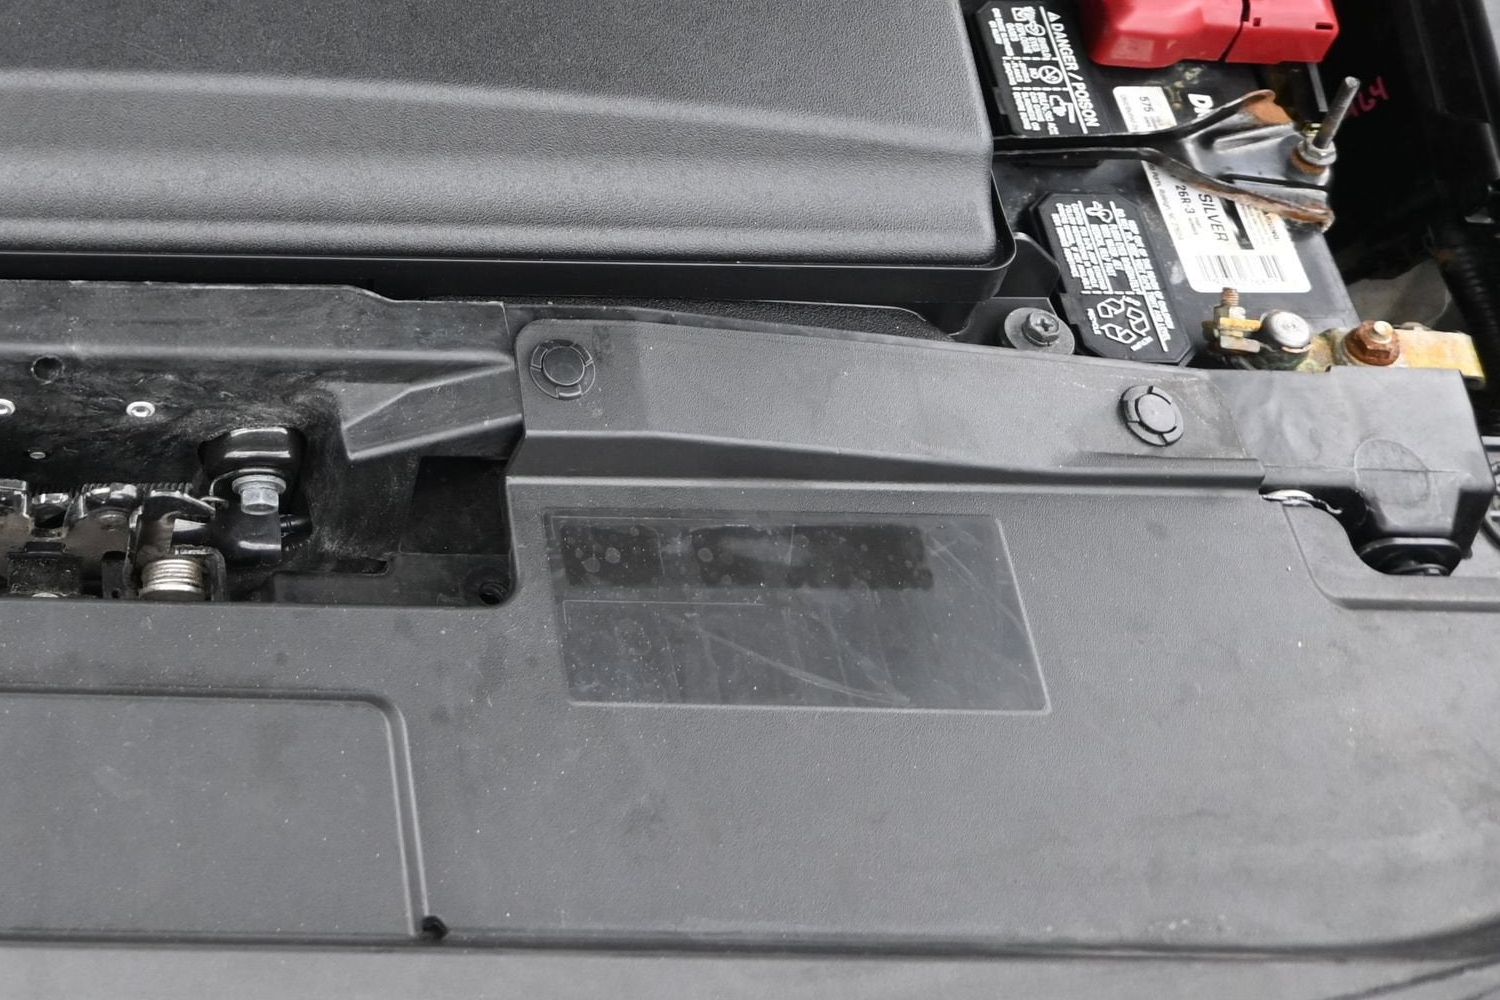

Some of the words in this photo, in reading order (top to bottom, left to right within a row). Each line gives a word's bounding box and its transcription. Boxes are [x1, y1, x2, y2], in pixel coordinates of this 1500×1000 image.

[1051, 23, 1079, 70] DANGER
[1072, 82, 1100, 126] POISON
[1138, 96, 1154, 112] 575
[1174, 184, 1196, 213] 26R-3
[1197, 193, 1229, 241] SILVER
